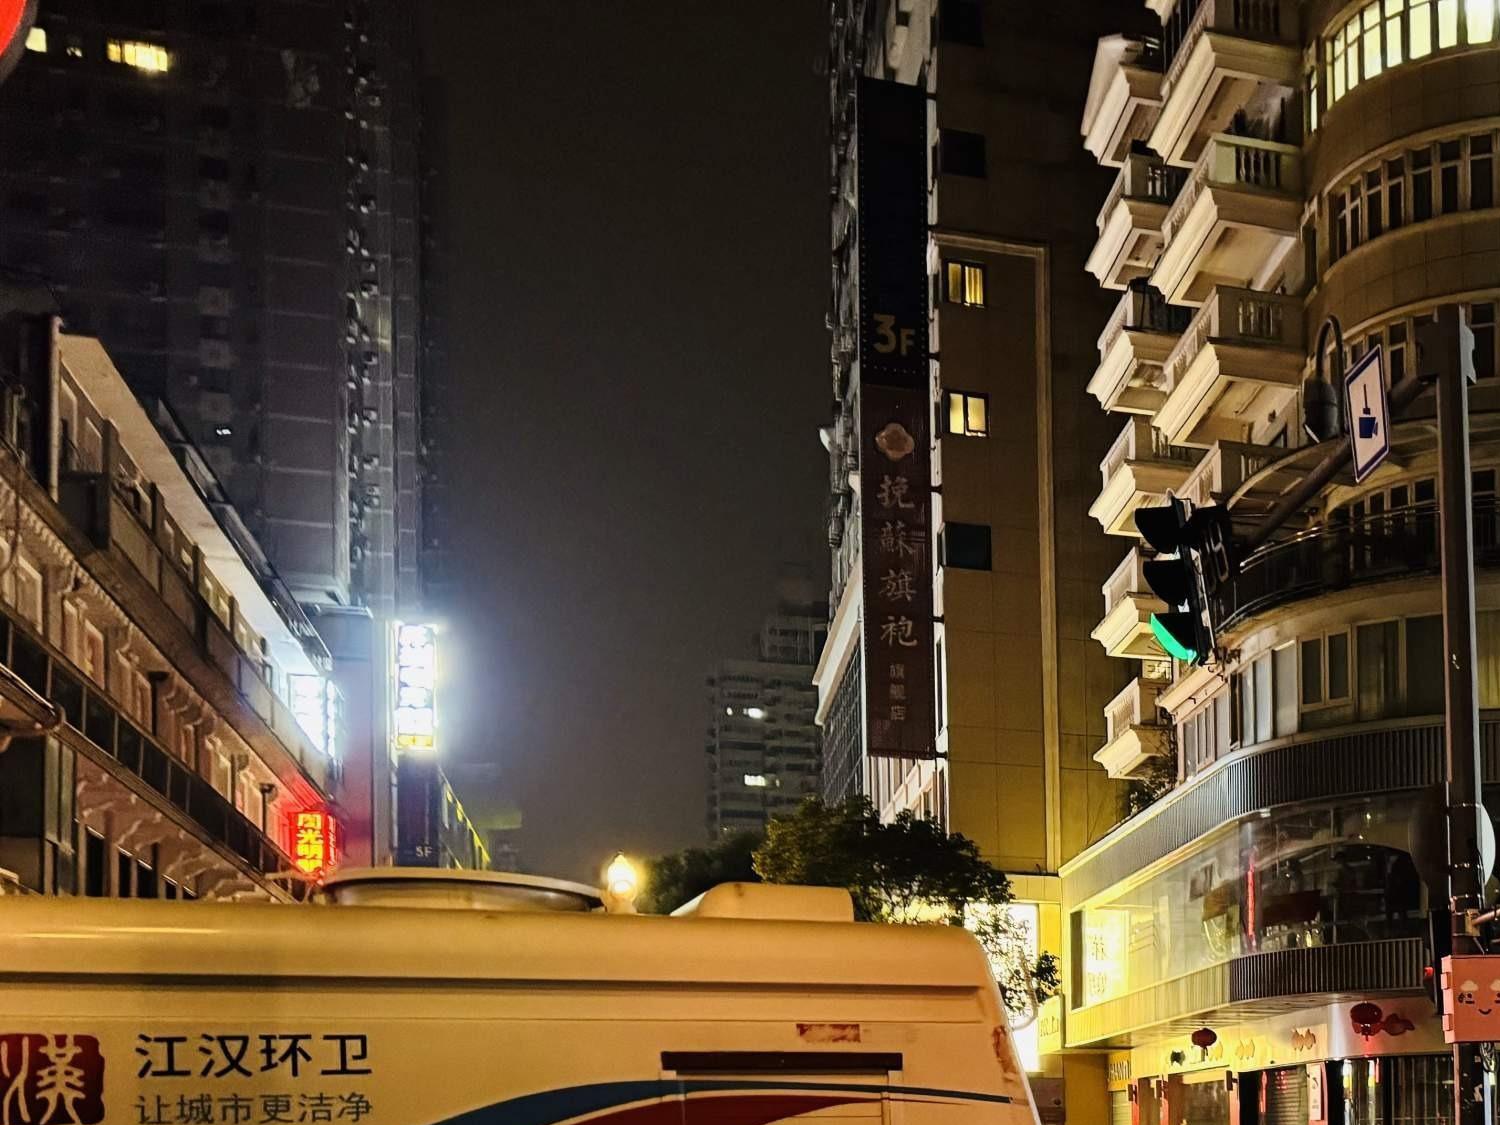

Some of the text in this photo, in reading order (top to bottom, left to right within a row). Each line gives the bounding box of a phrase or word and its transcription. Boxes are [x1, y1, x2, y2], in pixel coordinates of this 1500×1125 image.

[873, 313, 916, 356] 3F
[135, 1033, 372, 1079] 江汉环卫
[136, 1092, 372, 1125] 让城市更洁净
